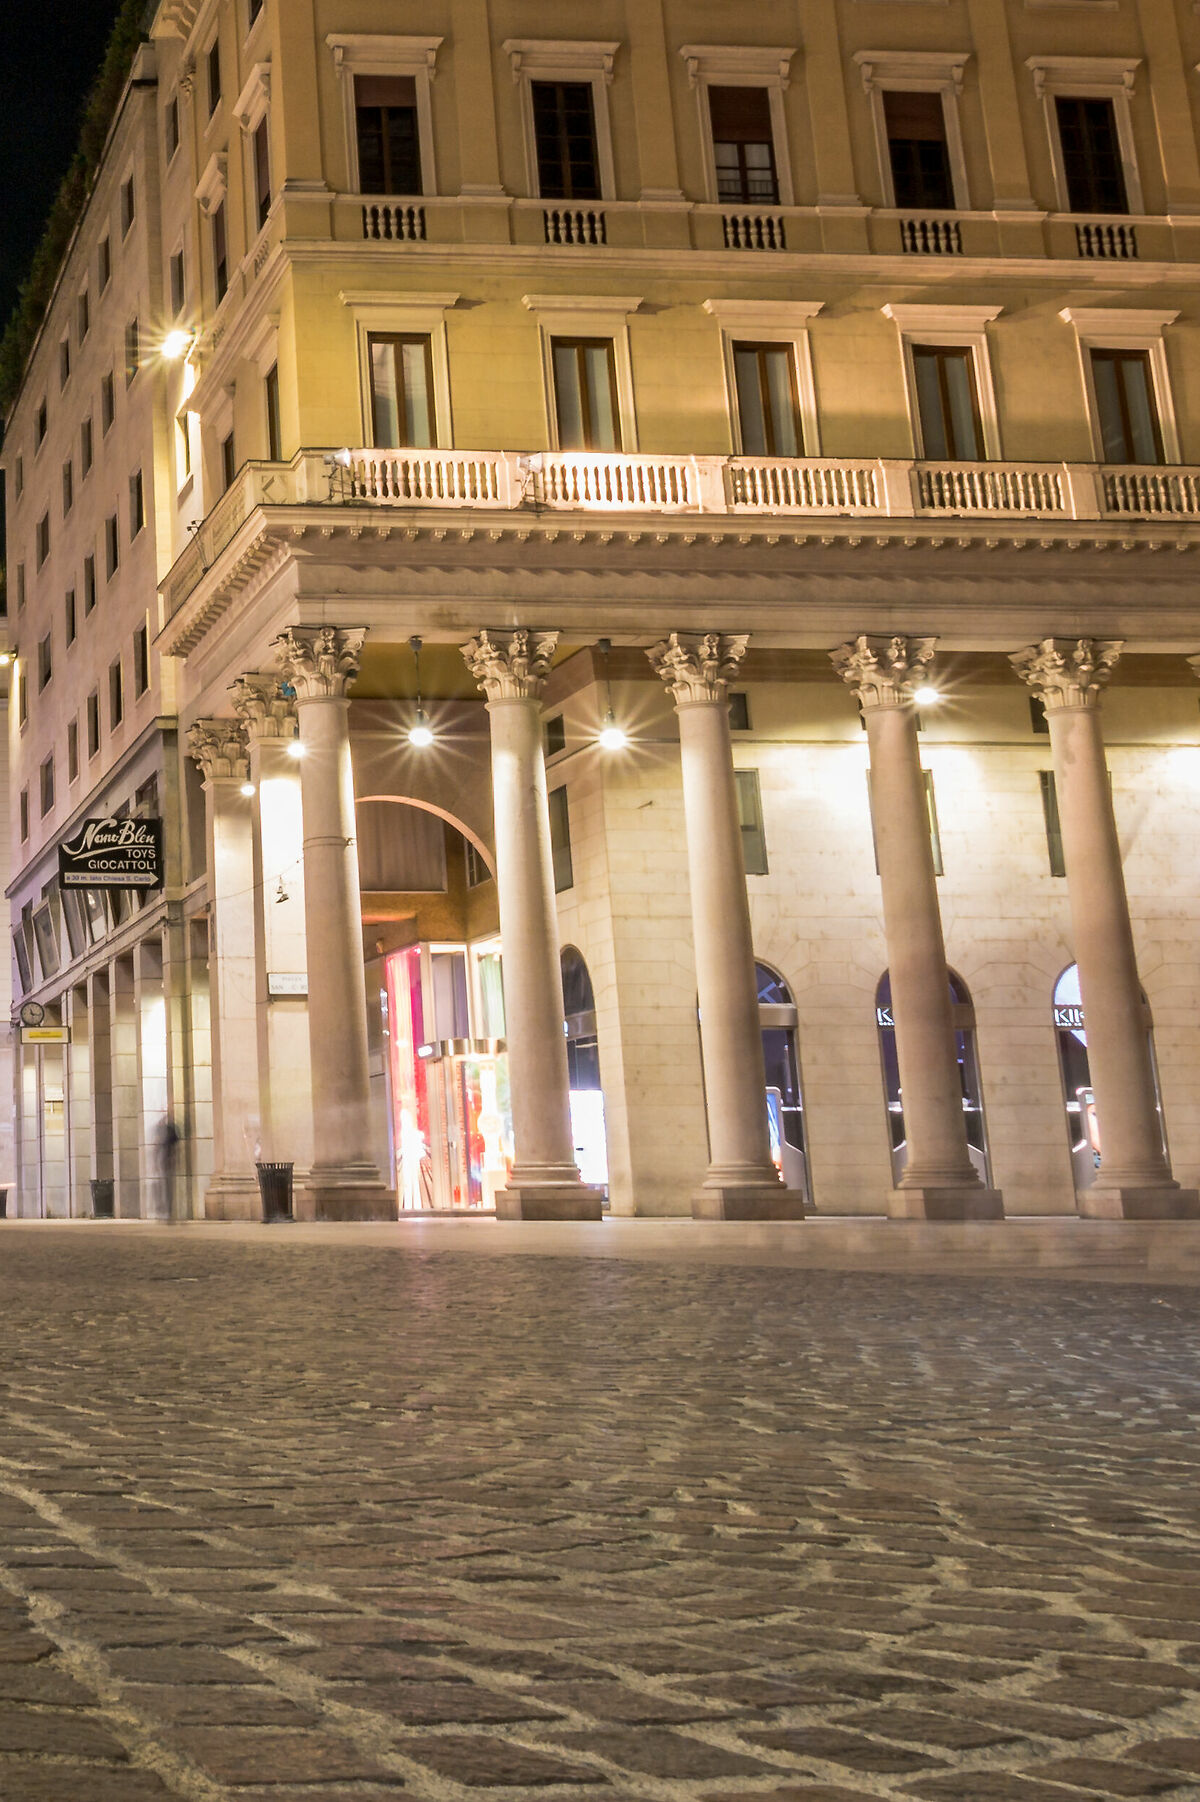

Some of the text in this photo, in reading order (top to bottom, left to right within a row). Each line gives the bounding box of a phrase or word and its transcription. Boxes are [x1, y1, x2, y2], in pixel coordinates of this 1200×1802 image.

[126, 849, 156, 859] TOYS
[88, 859, 156, 870] GIOCATTOLI
[1054, 1008, 1085, 1023] KIK
